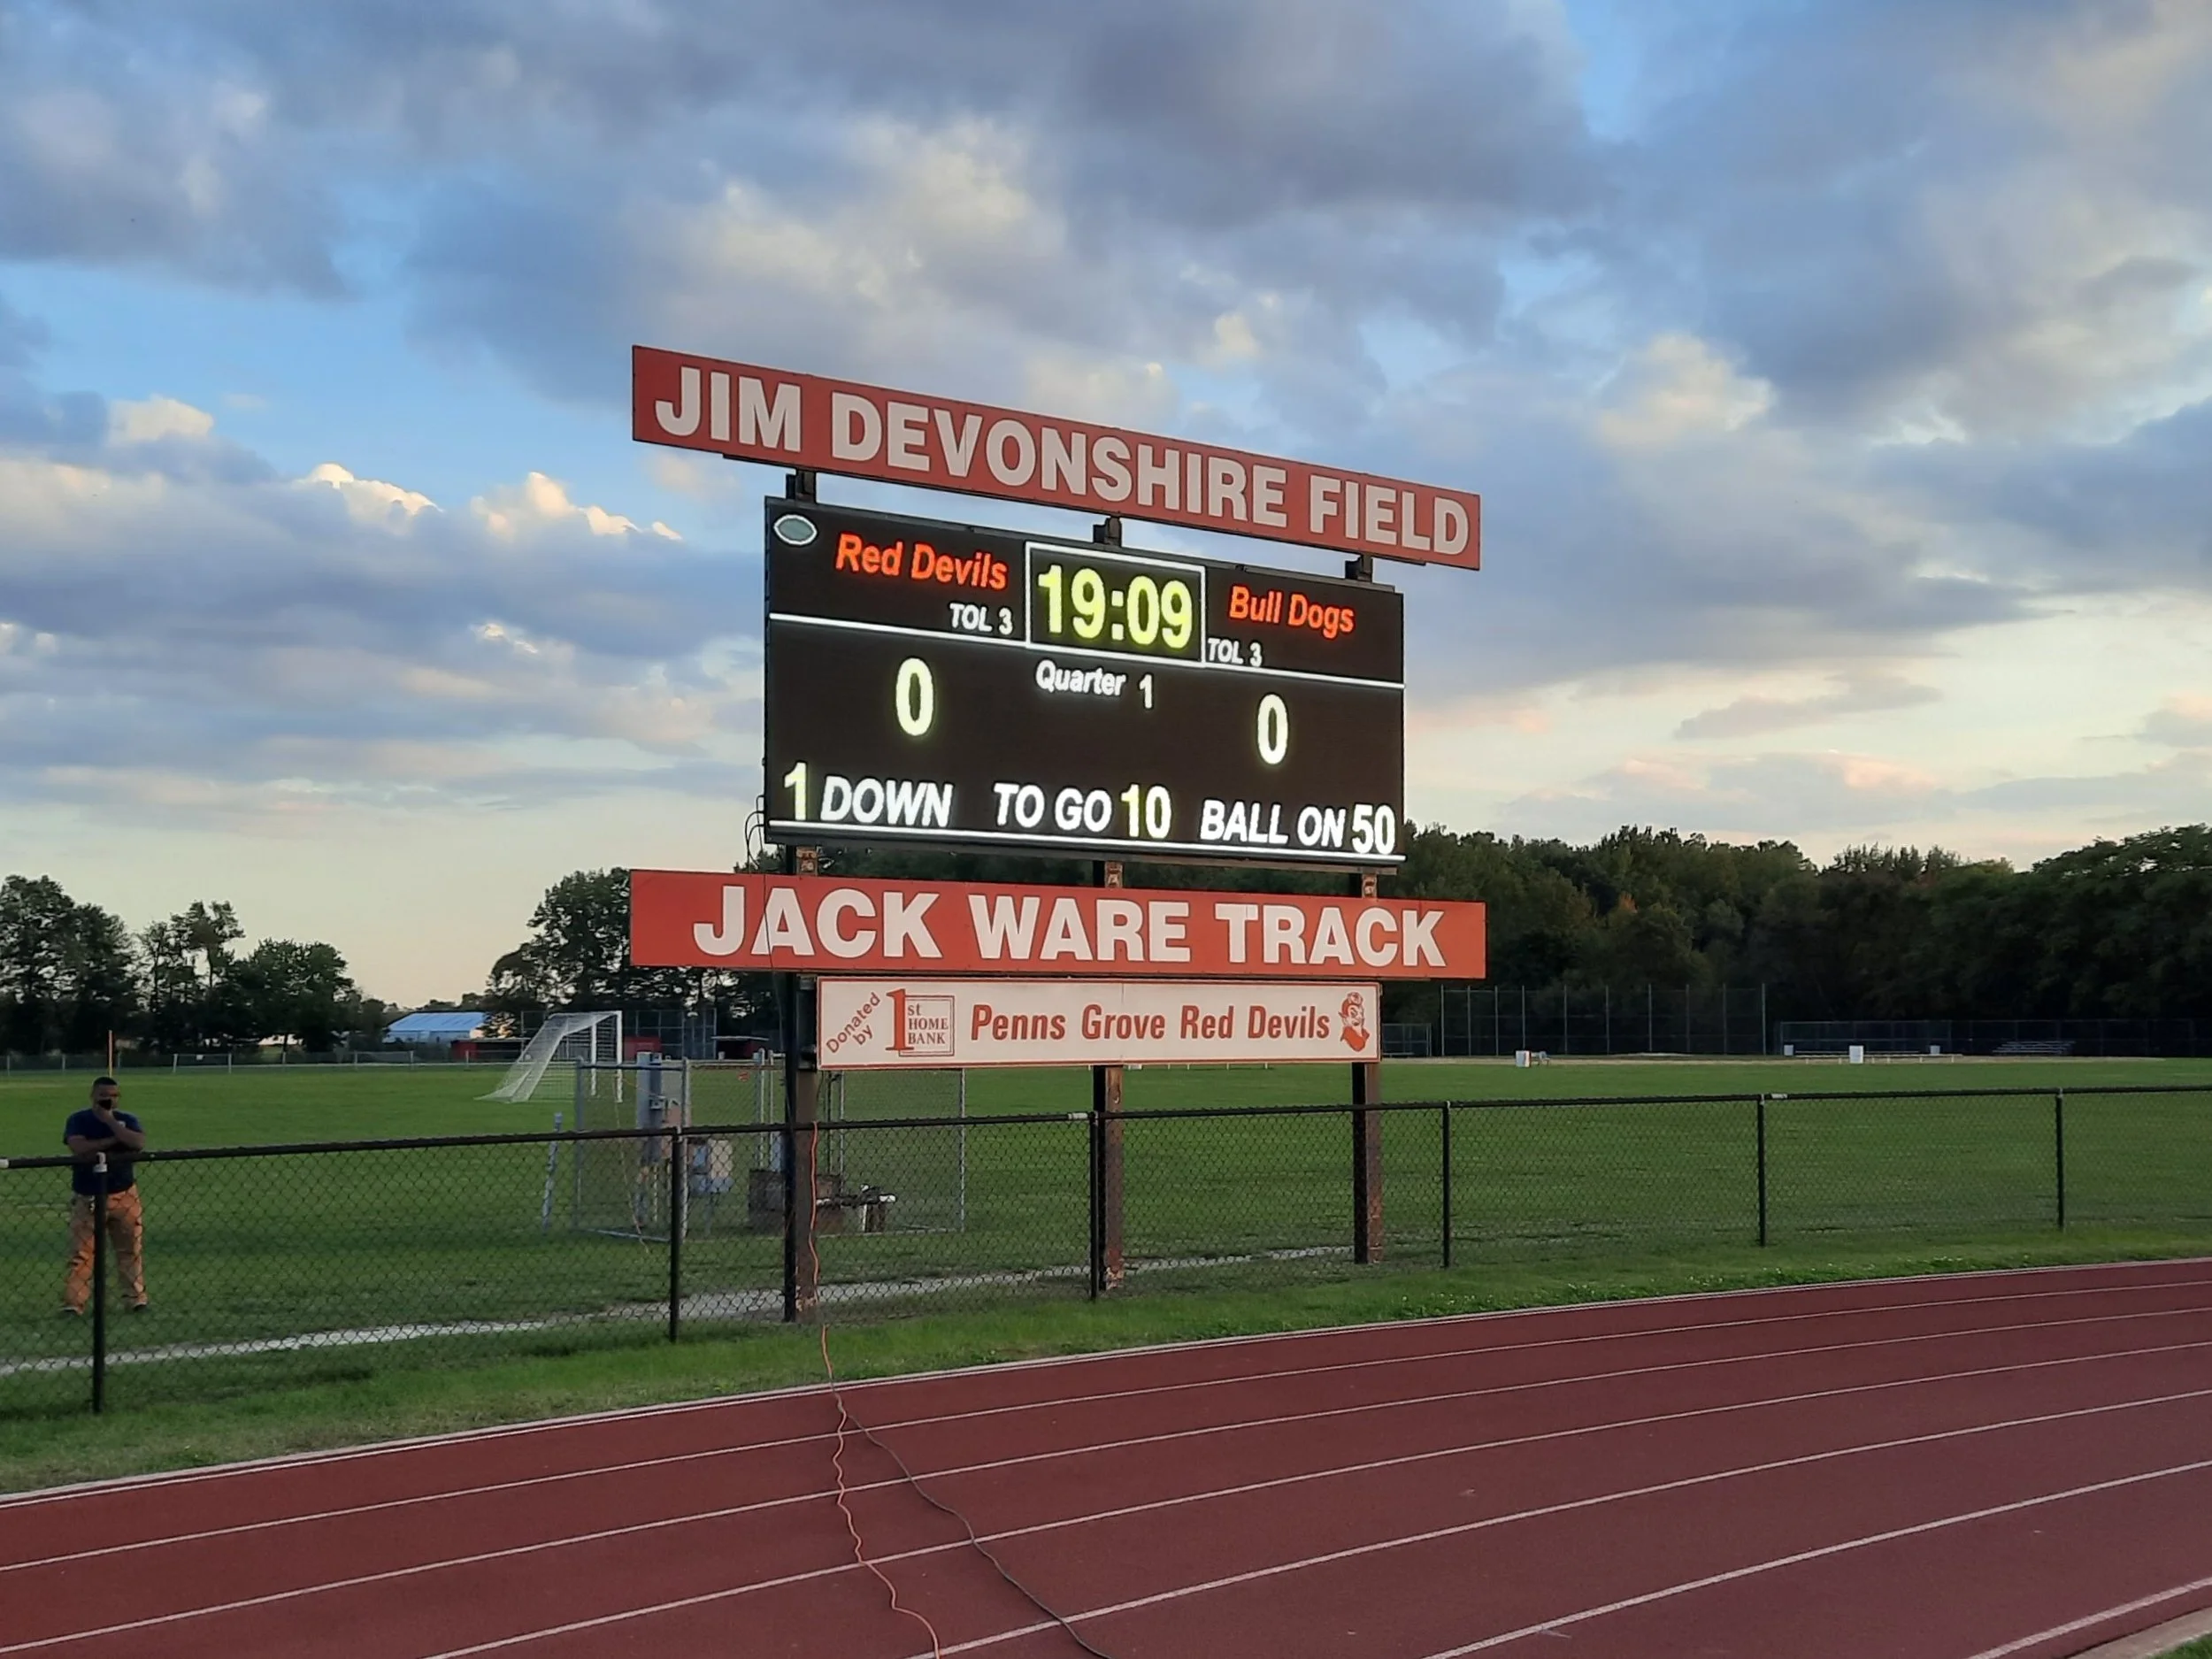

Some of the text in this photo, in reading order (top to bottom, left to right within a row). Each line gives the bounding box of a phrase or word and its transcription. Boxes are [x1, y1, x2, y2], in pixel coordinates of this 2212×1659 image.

[655, 365, 1470, 556] JIM DEVONSHIRE FIELD
[835, 534, 1009, 591] Red Devils
[949, 603, 1013, 635] TOL 3
[1038, 564, 1194, 649] 19:09
[1229, 585, 1355, 641] Bull Dogs
[1208, 638, 1263, 667] TOL 3
[895, 658, 934, 736] 0
[1037, 659, 1154, 710] Quarter 1
[1256, 693, 1290, 766] 0
[783, 761, 954, 829] 1 DOWN
[994, 782, 1172, 841] TO GO 10
[1200, 800, 1396, 856] BALL ON 50
[694, 885, 1446, 968] JACK WARE TRACK
[826, 992, 881, 1054] Donated
[852, 1025, 874, 1046] by
[908, 1018, 949, 1030] HOME
[908, 1033, 946, 1044] BANK
[972, 1004, 1330, 1041] Penns Grove Red Devils
